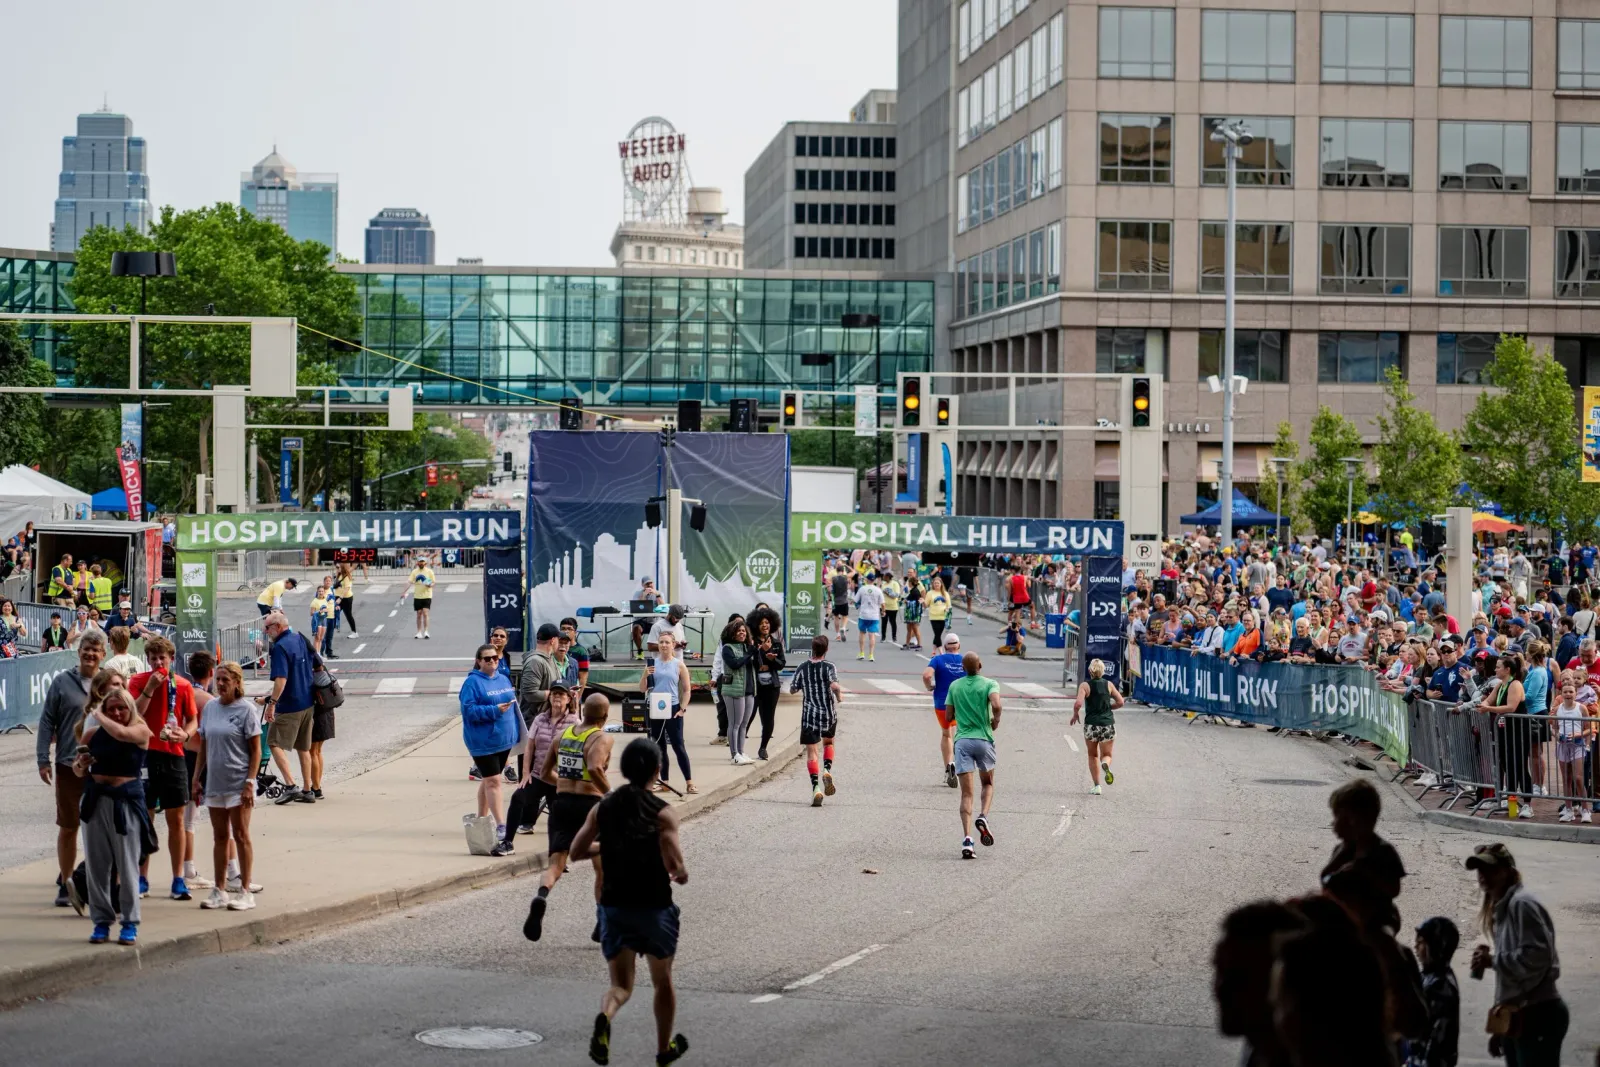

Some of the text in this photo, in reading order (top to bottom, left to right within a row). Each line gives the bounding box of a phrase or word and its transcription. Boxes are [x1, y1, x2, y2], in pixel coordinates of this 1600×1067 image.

[618, 133, 686, 159] WESTERN
[633, 161, 671, 184] AUTO
[1168, 422, 1210, 433] BREAD
[191, 517, 509, 544] HOSPITAL HILL RUN
[801, 519, 1113, 550] HOSPITAL HILL RUN
[746, 557, 780, 566] KANSAS
[487, 567, 519, 575] GARMIN
[752, 565, 773, 575] CITY
[491, 593, 518, 609] HDR
[1091, 601, 1117, 617] HDR
[182, 630, 207, 639] UMKC
[790, 627, 815, 635] UMKC
[1144, 659, 1279, 709] HOSITAL HILL RUN
[1311, 683, 1379, 725] HOSPITAL
[561, 756, 578, 767] 587
